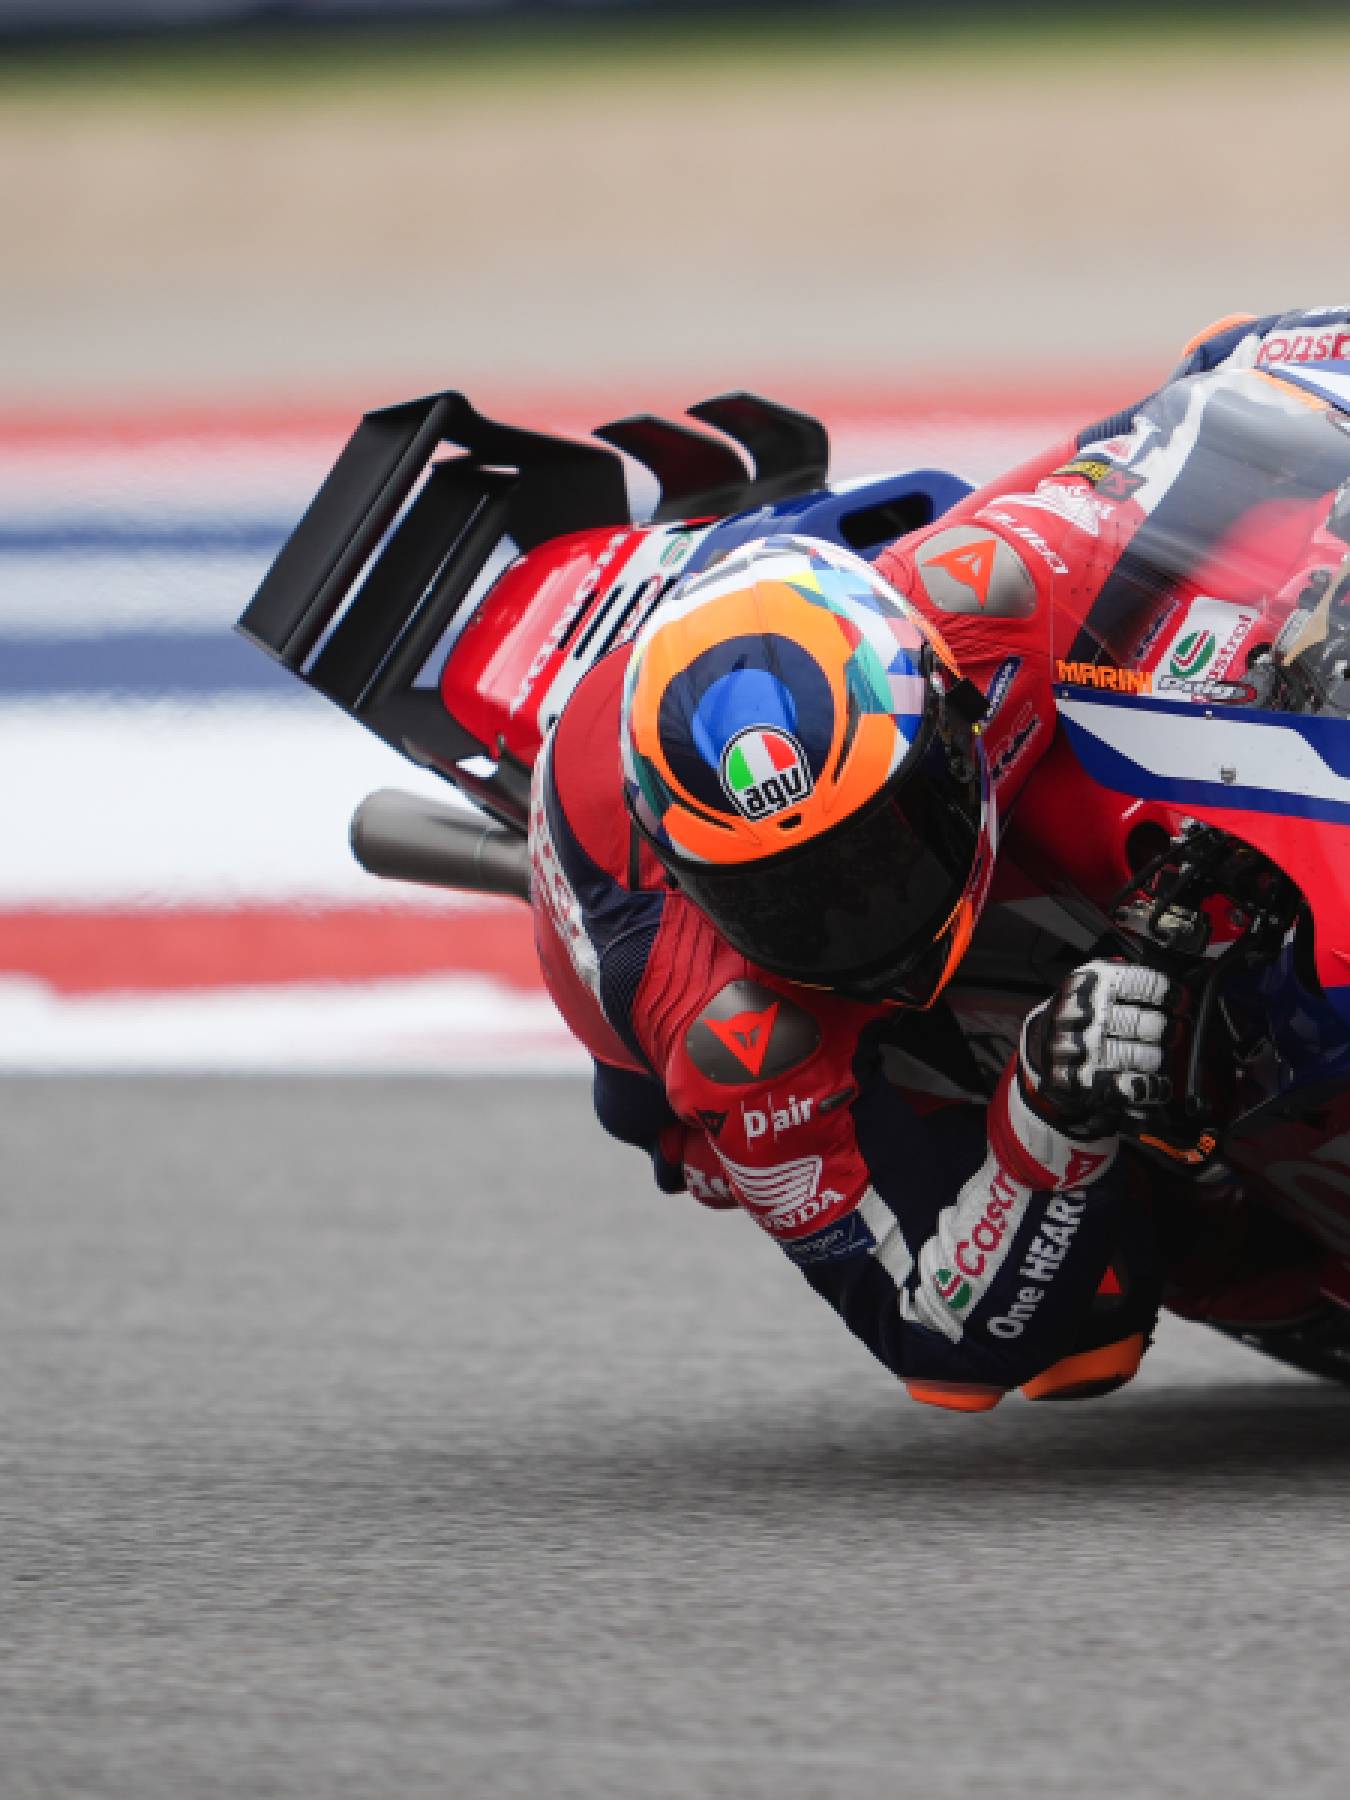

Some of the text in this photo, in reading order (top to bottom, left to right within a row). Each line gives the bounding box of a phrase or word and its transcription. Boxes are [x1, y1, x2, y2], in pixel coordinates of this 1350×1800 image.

[1055, 659, 1153, 694] MARINI
[743, 767, 803, 815] agv
[954, 1171, 1018, 1277] Castr
[986, 1286, 1046, 1339] One
